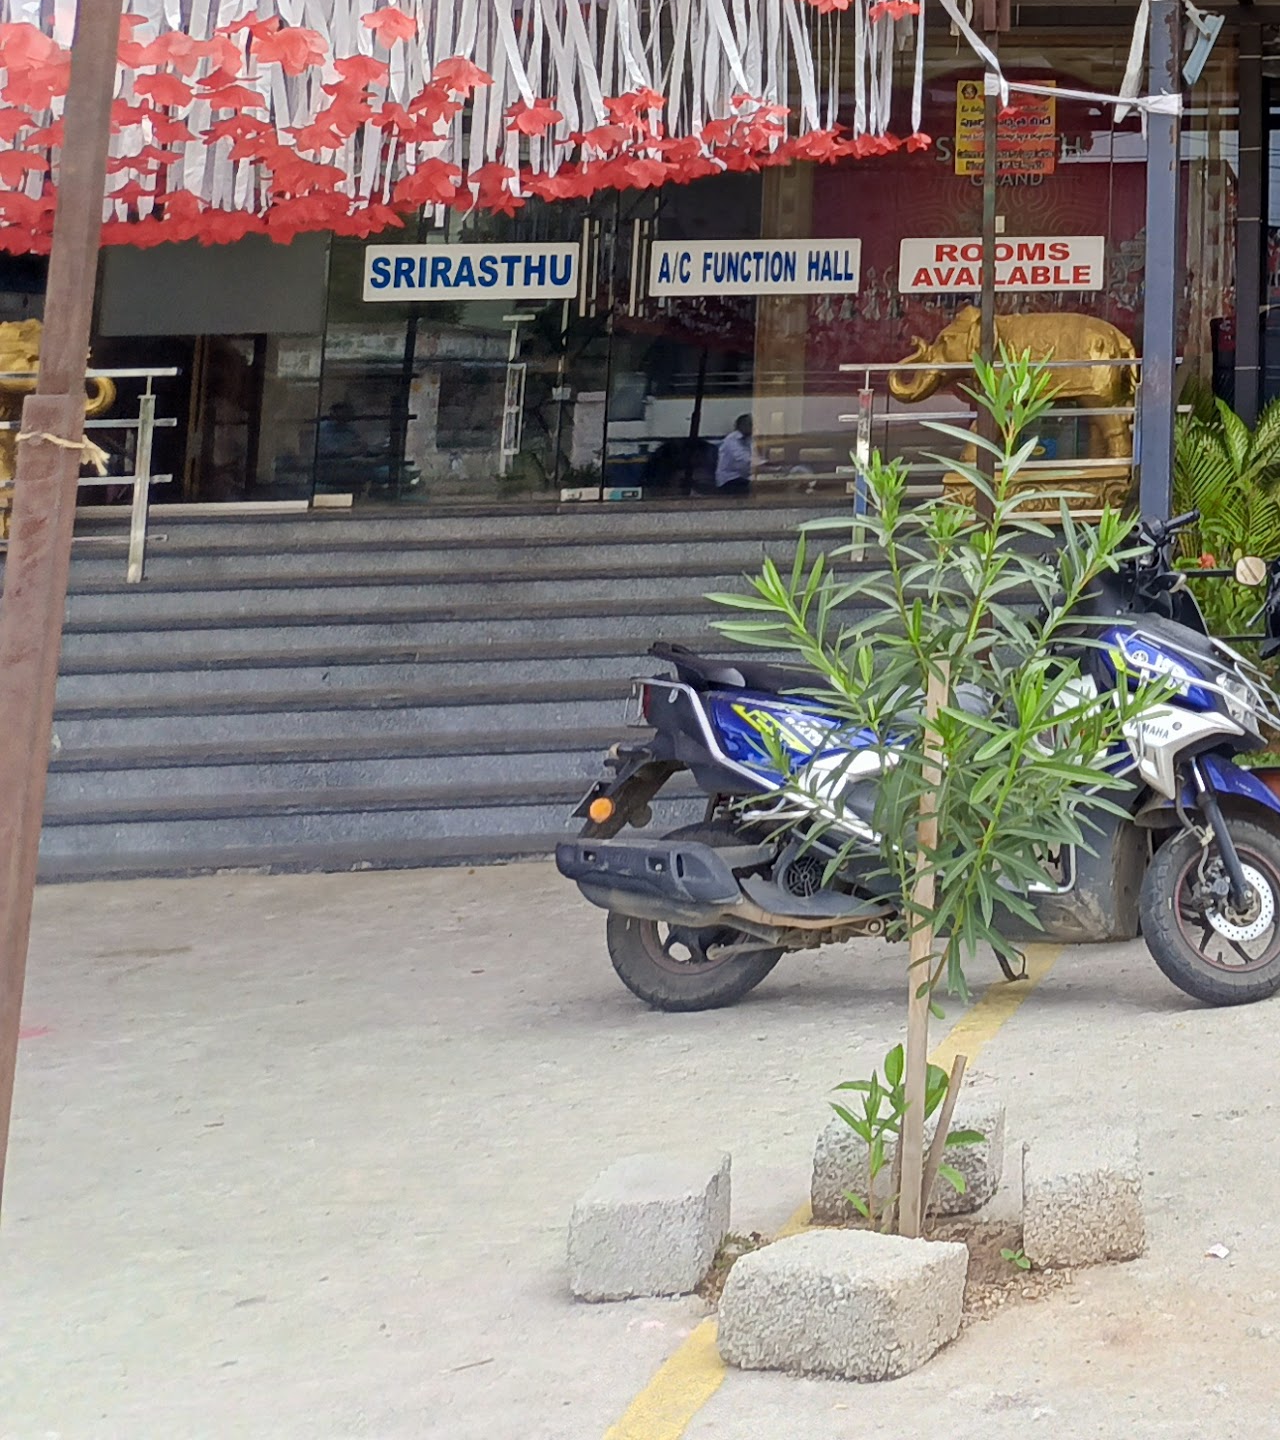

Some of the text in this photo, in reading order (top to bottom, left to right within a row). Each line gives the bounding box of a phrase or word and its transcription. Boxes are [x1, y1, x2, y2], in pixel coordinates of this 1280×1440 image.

[970, 173, 1044, 187] GAND
[934, 242, 1071, 262] ROOMS
[369, 249, 854, 289] SRIRASTHU A/C FUNCTION HALL
